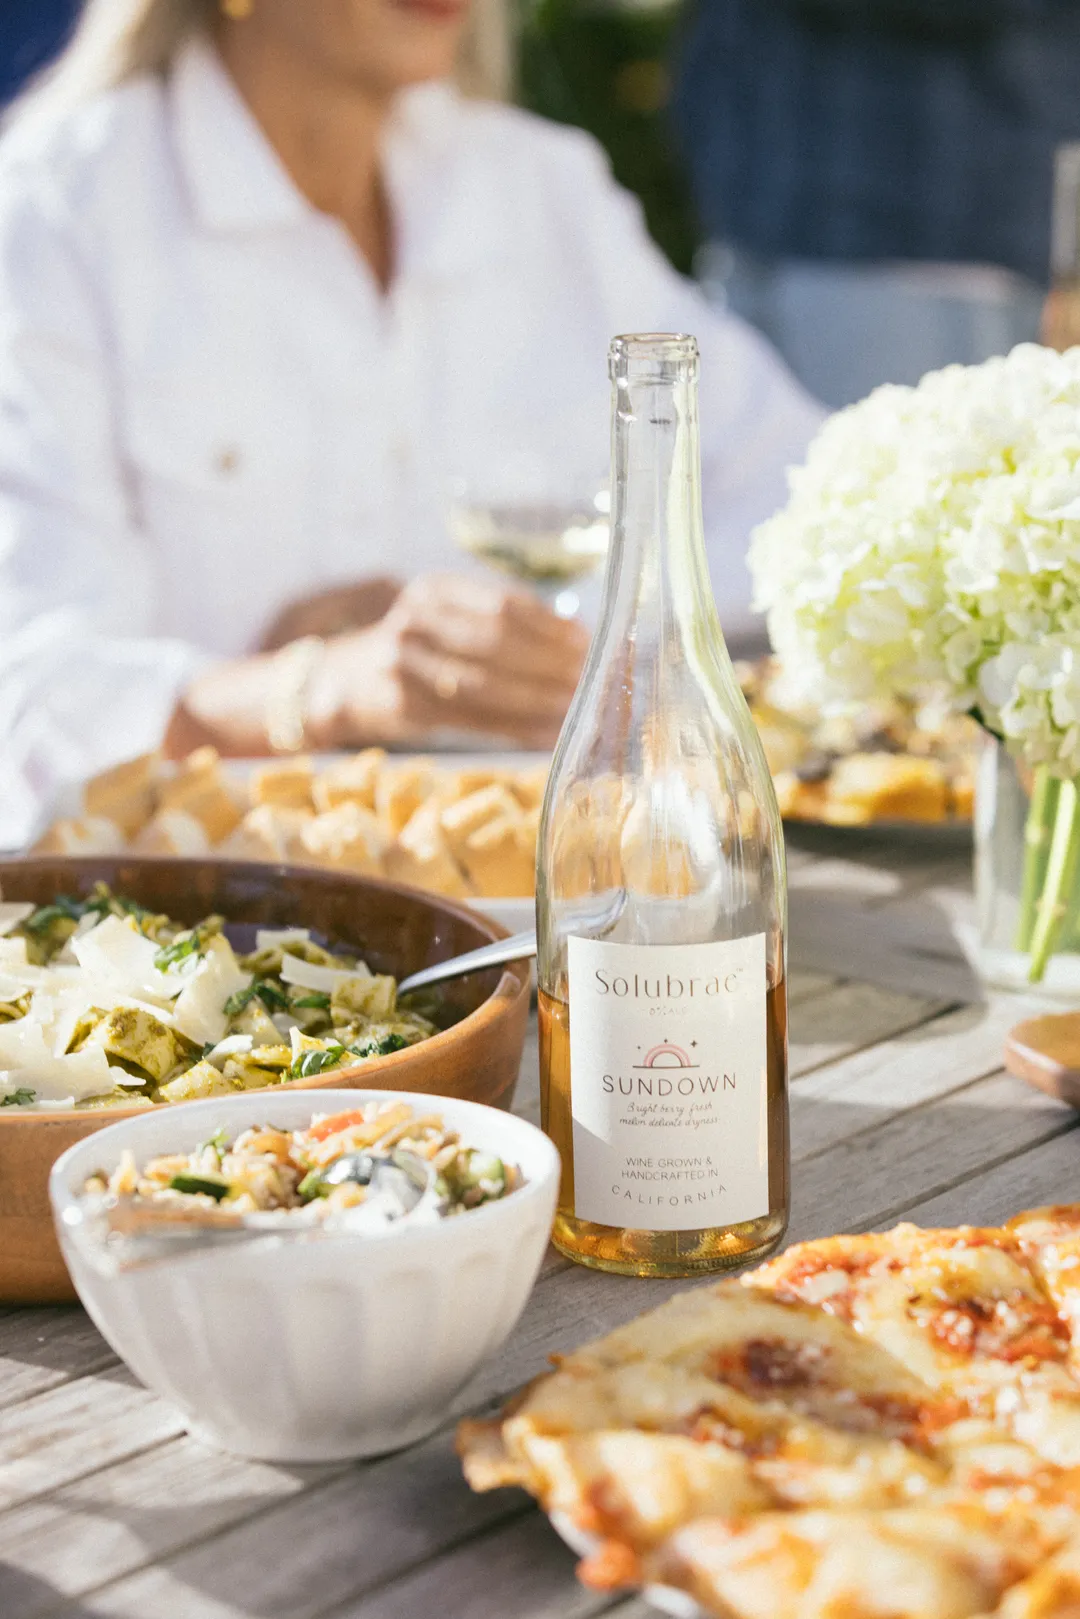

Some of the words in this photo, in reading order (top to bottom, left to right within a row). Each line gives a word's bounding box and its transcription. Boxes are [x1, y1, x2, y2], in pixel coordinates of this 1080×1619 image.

[602, 1072, 737, 1097] SUNDOWN
[627, 1102, 658, 1117] Bright
[688, 1102, 713, 1118] fresh
[626, 1157, 653, 1168] WINE
[658, 1157, 702, 1168] GROWN
[704, 1156, 713, 1166] &
[621, 1169, 705, 1181] HANDCRAFTED
[707, 1167, 718, 1178] IN
[611, 1184, 728, 1207] CALIFORNIA
